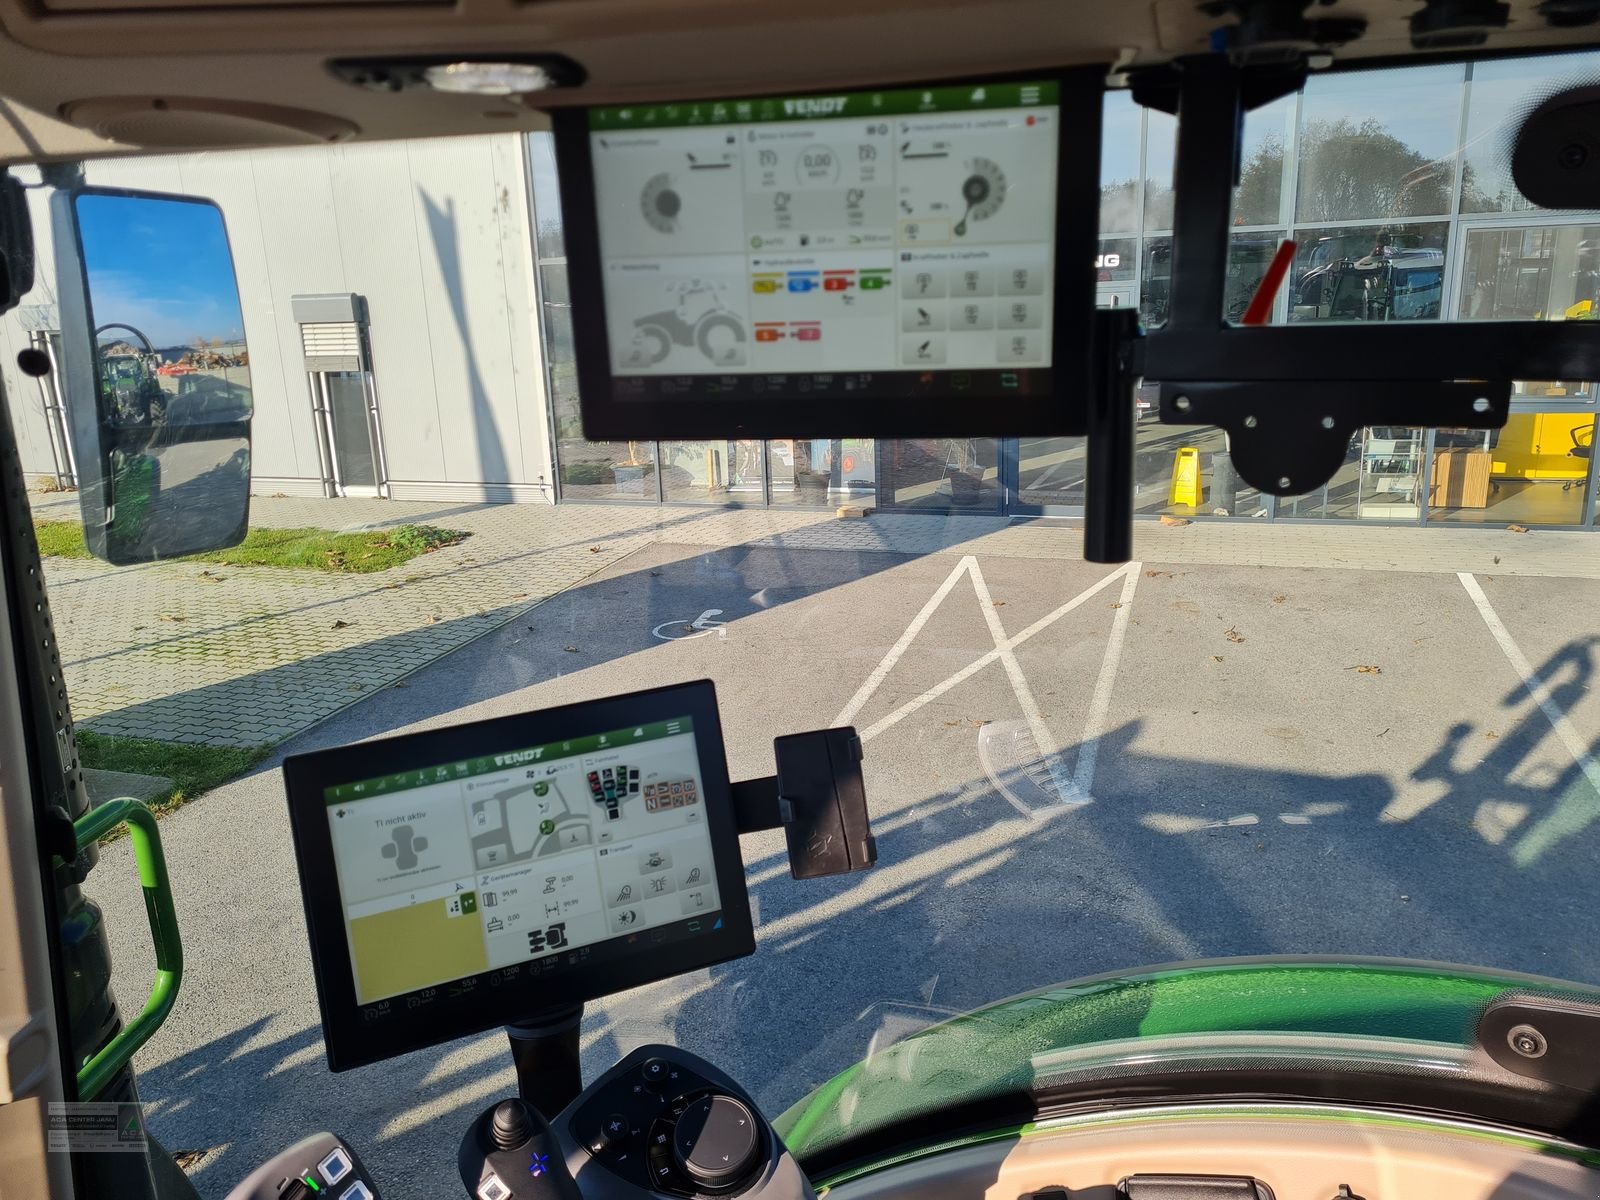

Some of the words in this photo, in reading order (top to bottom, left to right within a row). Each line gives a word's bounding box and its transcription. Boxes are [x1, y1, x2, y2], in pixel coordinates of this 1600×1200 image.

[783, 97, 847, 114] FENDT
[494, 747, 544, 766] FENDT
[385, 815, 406, 827] nicht
[407, 811, 426, 823] aktiv
[502, 966, 520, 977] 1200
